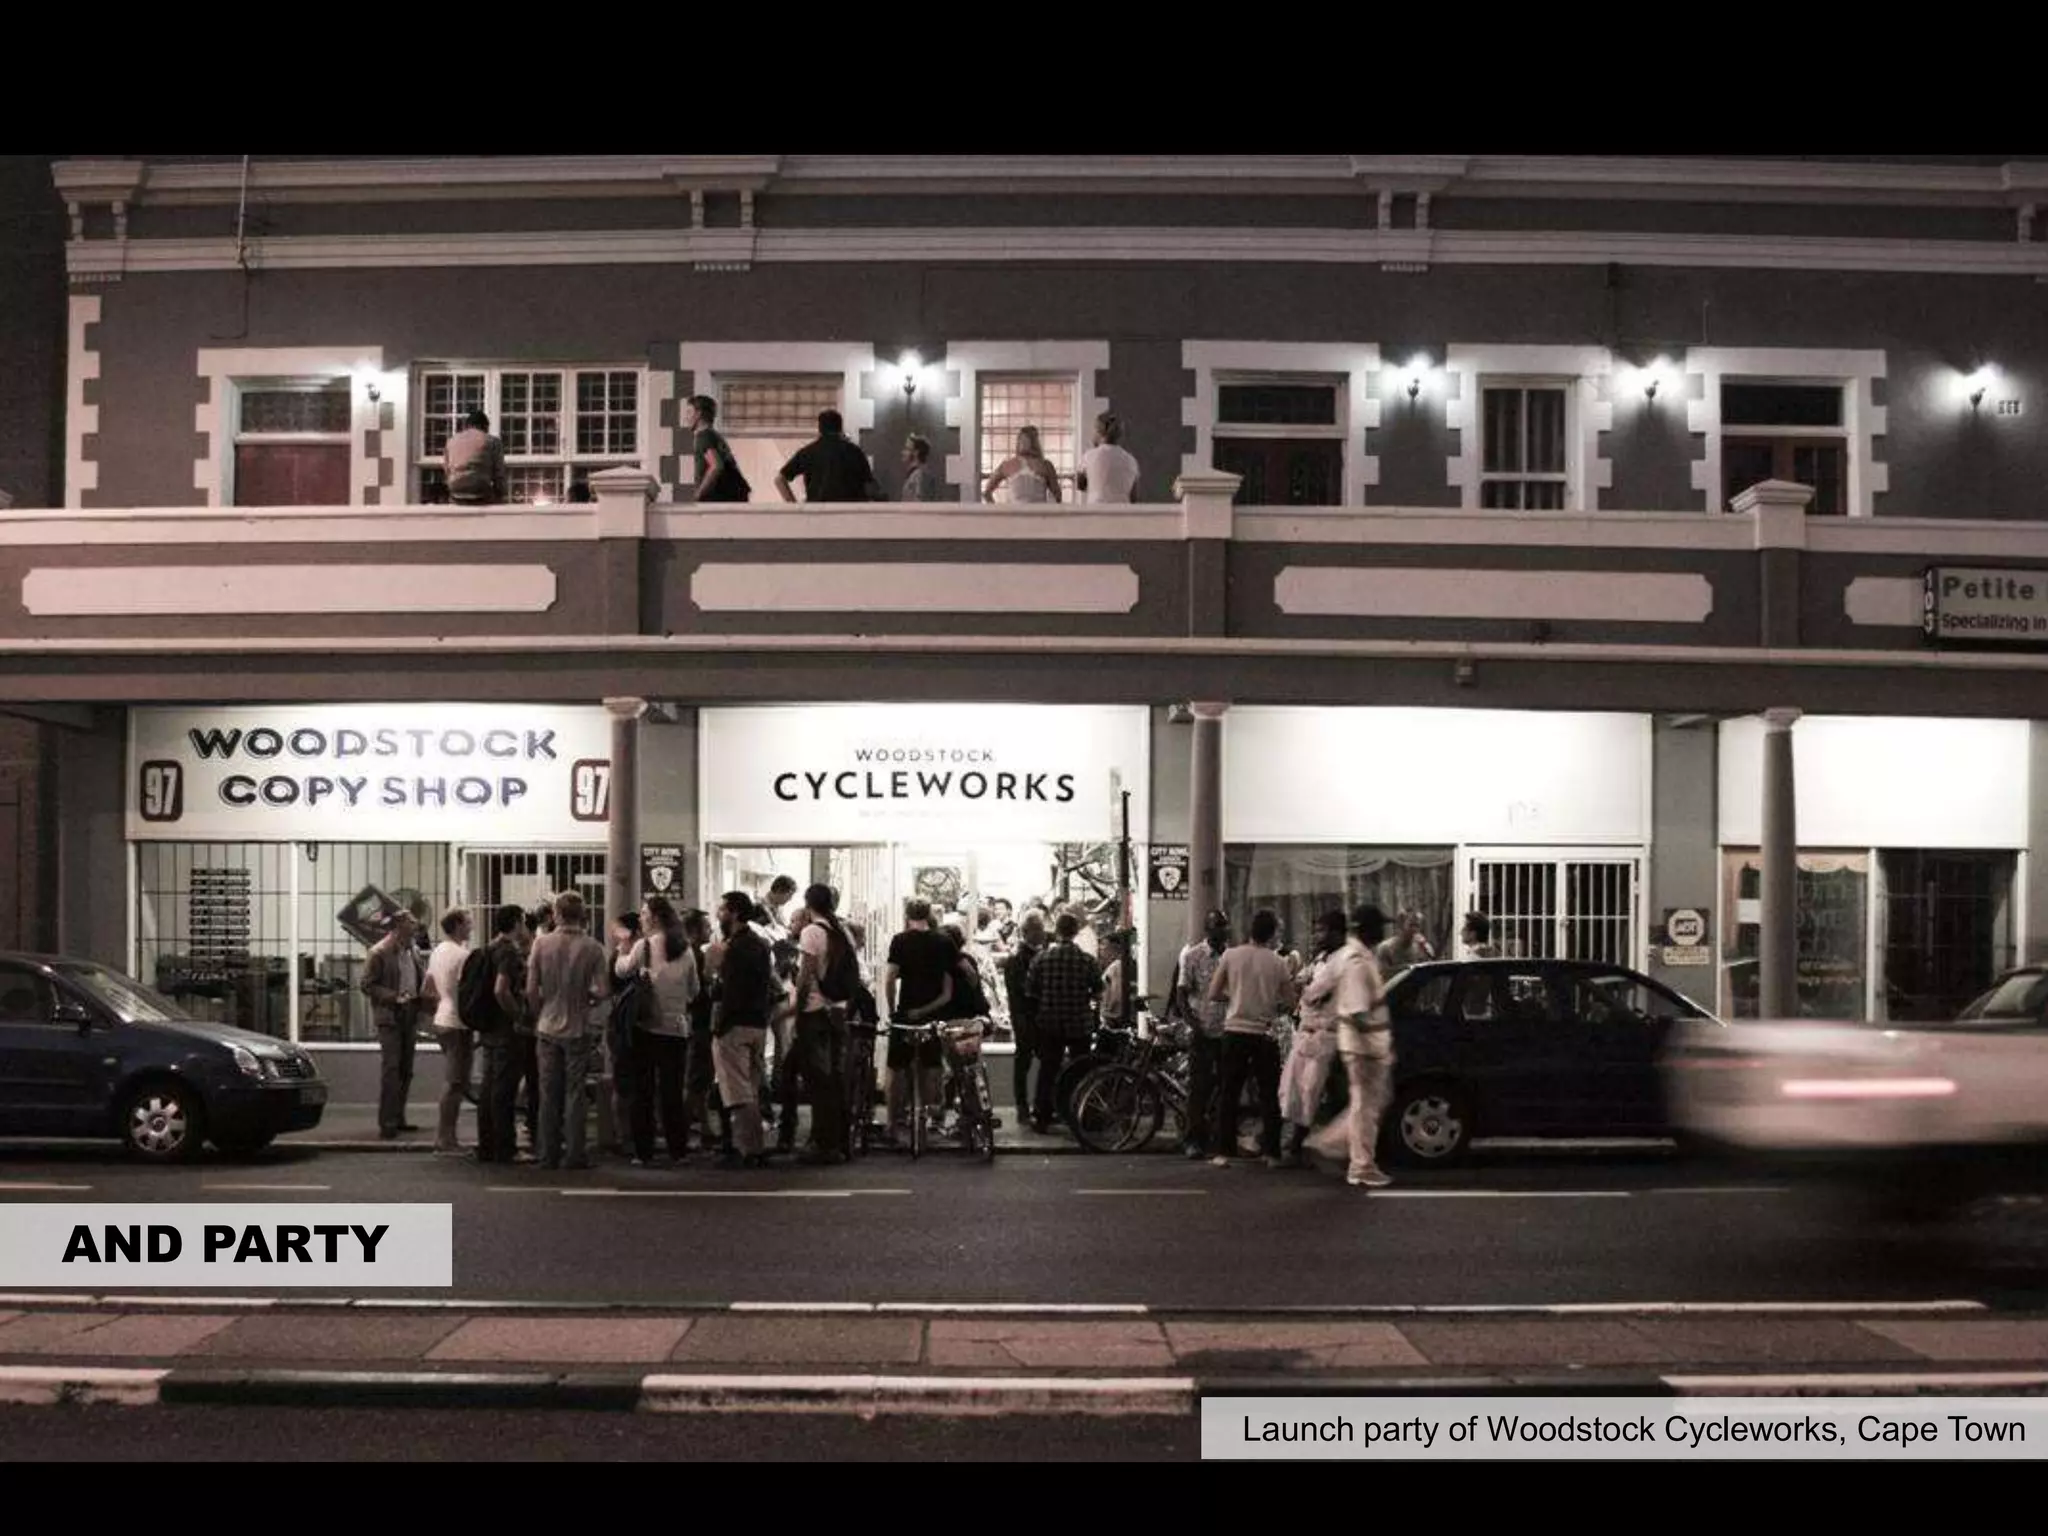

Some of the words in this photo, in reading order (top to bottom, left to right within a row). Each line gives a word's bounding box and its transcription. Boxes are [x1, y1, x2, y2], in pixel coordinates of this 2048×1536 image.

[1942, 576, 2035, 601] Petite
[1943, 613, 2029, 633] Specializing
[187, 727, 558, 760] WOODSTOCK
[855, 748, 994, 762] WOODSTOCK
[145, 766, 179, 818] 97
[218, 775, 368, 807] COPY
[382, 776, 528, 807] SHOP
[576, 765, 609, 816] 97
[774, 771, 1075, 803] CYCLEWORKS
